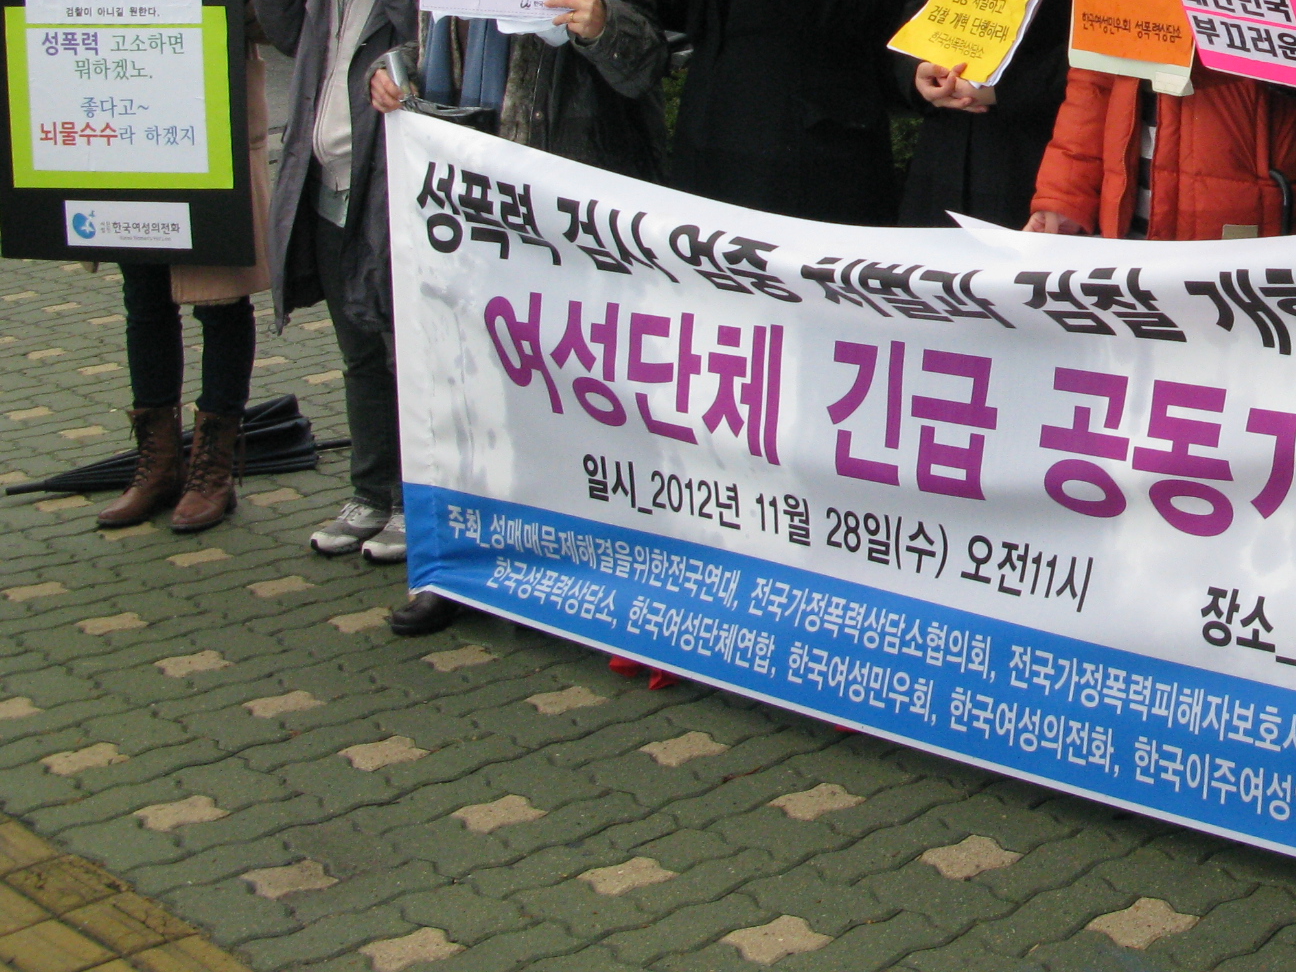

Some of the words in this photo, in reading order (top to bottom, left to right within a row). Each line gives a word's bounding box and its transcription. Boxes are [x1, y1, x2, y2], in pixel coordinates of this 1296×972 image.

[66, 7, 92, 17] 검찰이
[97, 7, 124, 17] 아니길
[129, 7, 160, 17] 원한다.
[928, 5, 950, 24] 검찰
[950, 12, 971, 32] 개혁
[41, 32, 100, 56] 성폭력
[111, 32, 185, 55] 고소하면
[74, 58, 153, 81] 뭐하겠노.
[80, 96, 150, 118] 좋다고~
[39, 122, 136, 146] 뇌물수수라
[145, 125, 196, 147] 하겠지
[112, 221, 180, 235] 한국여성의전화
[417, 162, 562, 266] 성폭력
[557, 197, 680, 283] 검사
[669, 224, 803, 304] 엄중
[800, 257, 1017, 329] 처벌과
[1013, 267, 1187, 343] 검찰
[484, 291, 784, 466] 여성단체
[827, 340, 998, 502] 긴급
[755, 492, 811, 547] 11월
[826, 506, 948, 579] 28일(수)
[960, 534, 1094, 613] 오전11시
[749, 577, 997, 683] 전국가정폭력상담소협의회,
[486, 556, 617, 629] 한국성폭력상담소,
[626, 595, 775, 679] 한국여성단체연합,
[788, 641, 936, 727] 한국여성민우회,
[950, 686, 1119, 778] 한국여성의전화,
